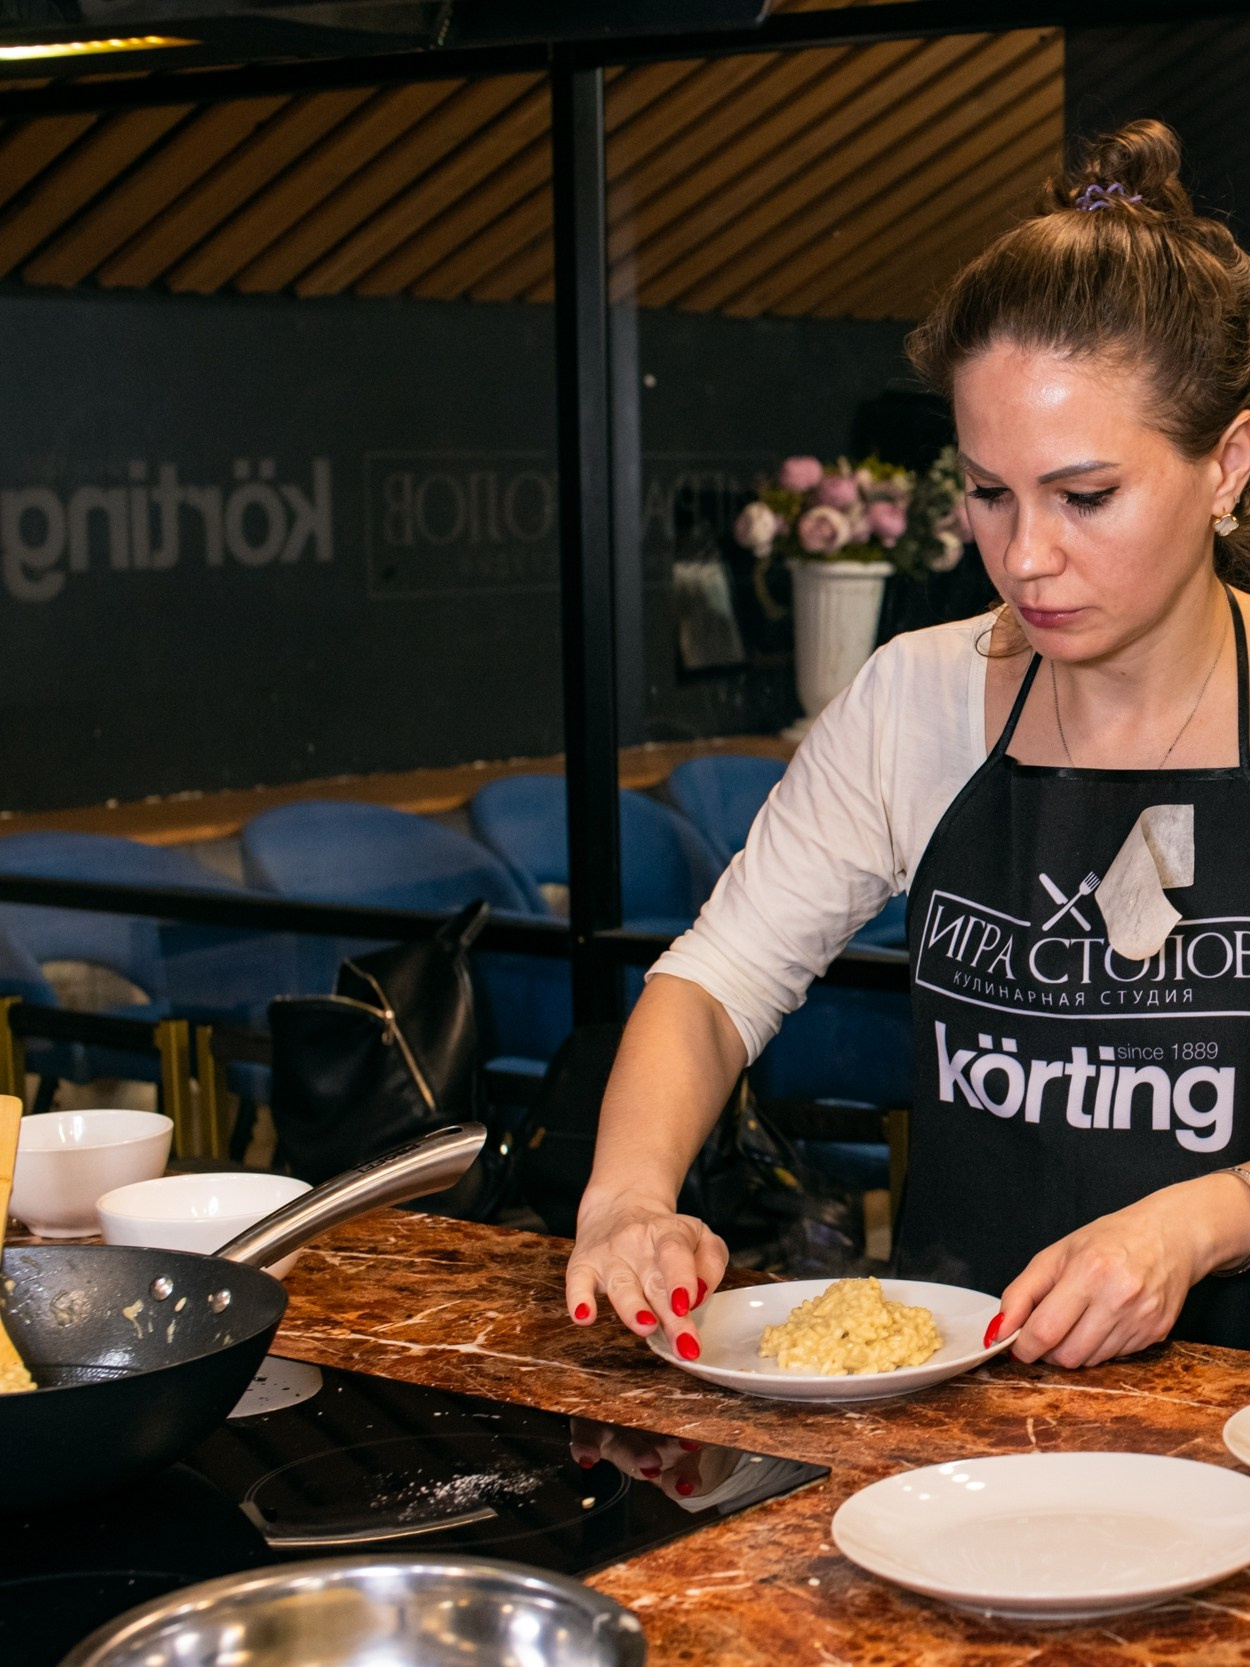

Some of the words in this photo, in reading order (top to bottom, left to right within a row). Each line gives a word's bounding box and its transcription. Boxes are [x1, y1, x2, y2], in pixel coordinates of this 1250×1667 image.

[927, 905, 1017, 980] ИГРА
[953, 970, 1085, 1007] КУЛИНАРНАЯ
[1100, 988, 1193, 1007] СТУДИЯ
[1117, 1043, 1164, 1060] since
[1171, 1042, 1219, 1060] 1889
[935, 1020, 1236, 1153] körting
